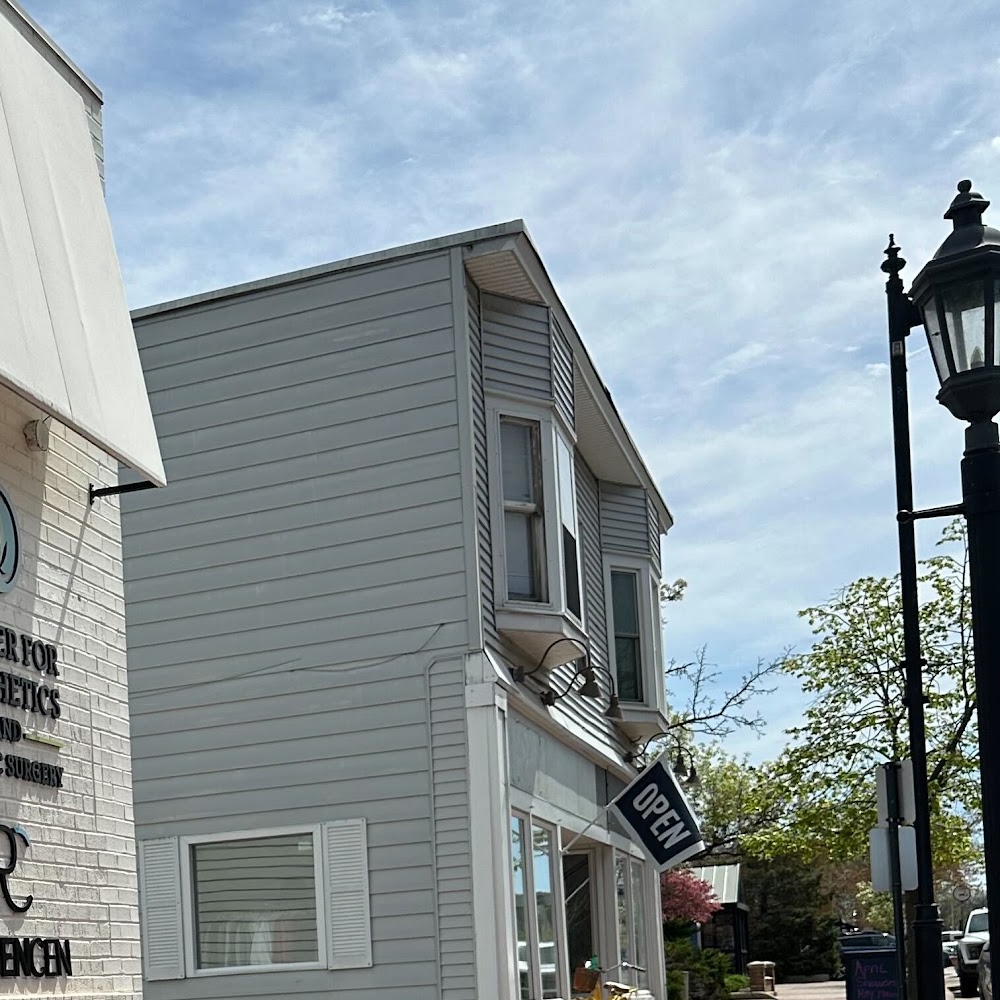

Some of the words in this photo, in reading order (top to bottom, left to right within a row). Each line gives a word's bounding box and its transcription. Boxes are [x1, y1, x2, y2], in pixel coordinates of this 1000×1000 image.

[20, 634, 60, 676] FOR
[4, 754, 64, 788] SURGERY
[632, 782, 692, 850] OPEN
